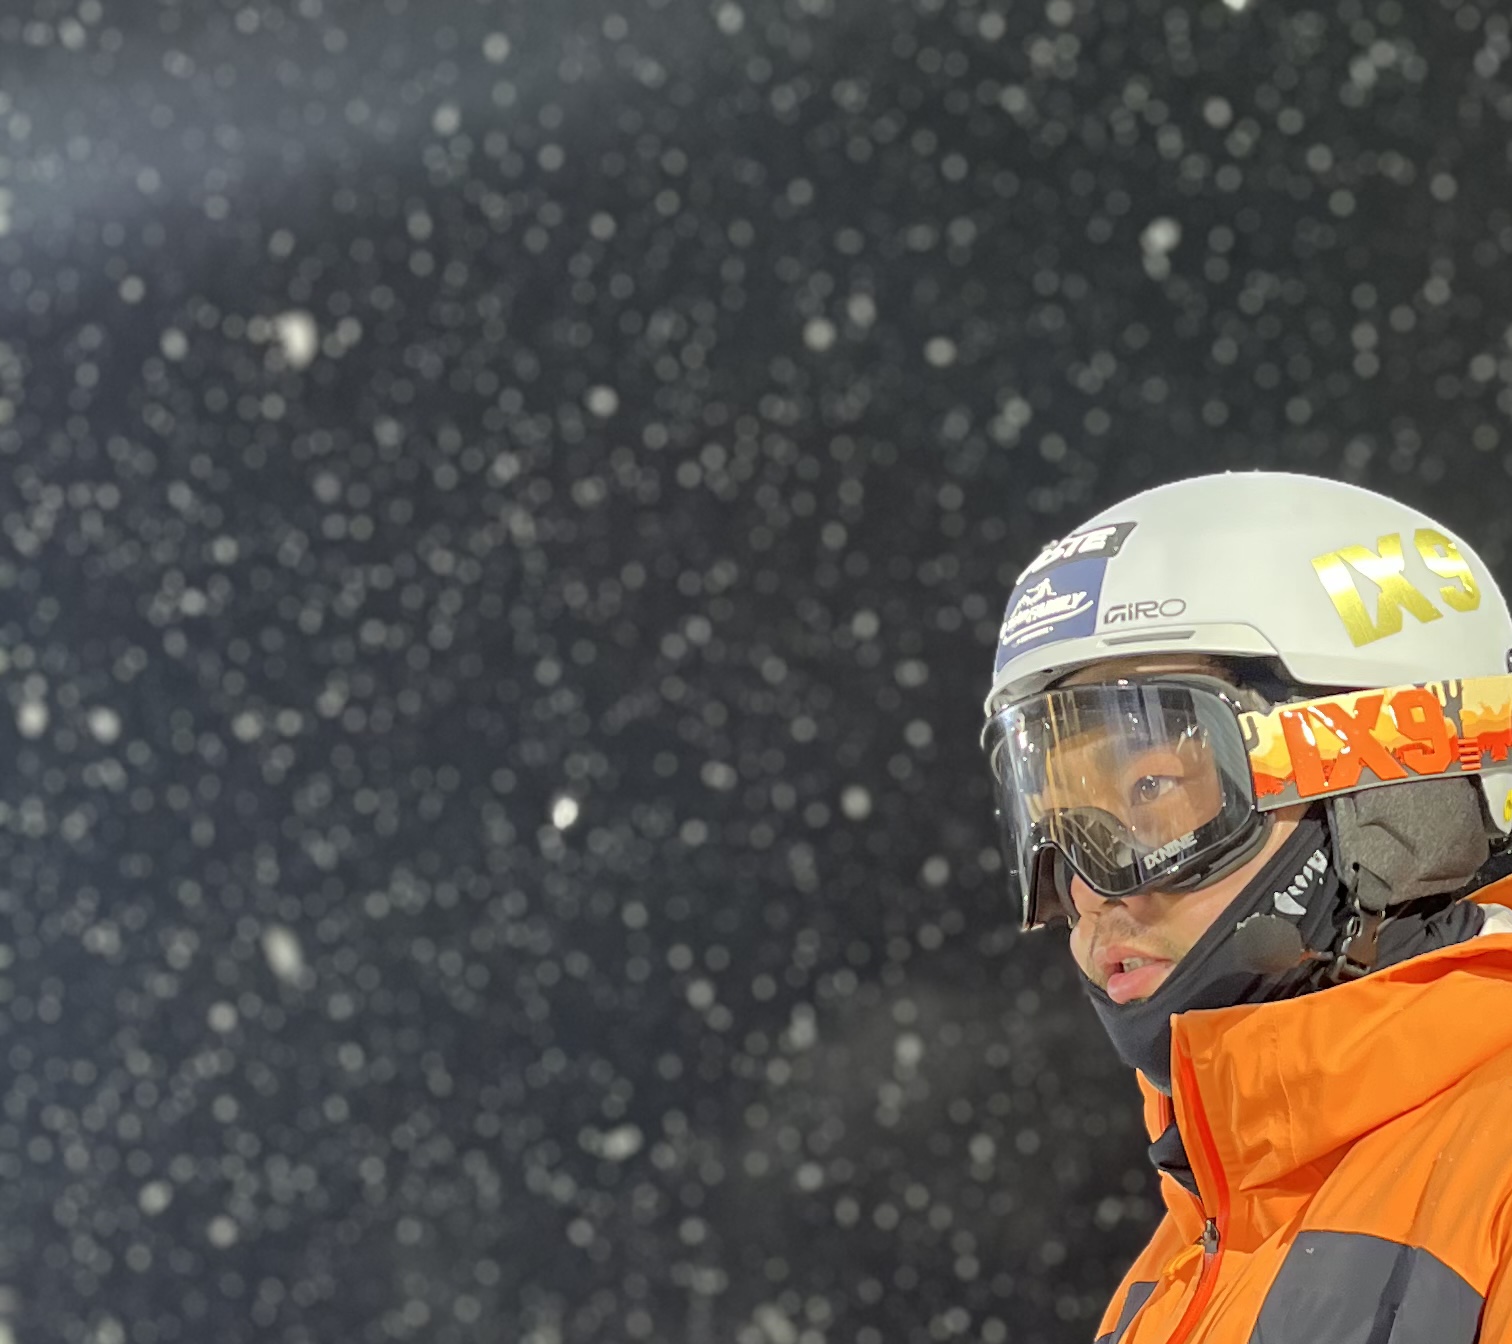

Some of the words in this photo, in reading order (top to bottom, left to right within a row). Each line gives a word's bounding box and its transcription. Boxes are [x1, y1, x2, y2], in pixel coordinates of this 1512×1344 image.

[1104, 598, 1187, 624] GIRO
[1310, 528, 1481, 648] IX9
[1279, 687, 1453, 798] IX9
